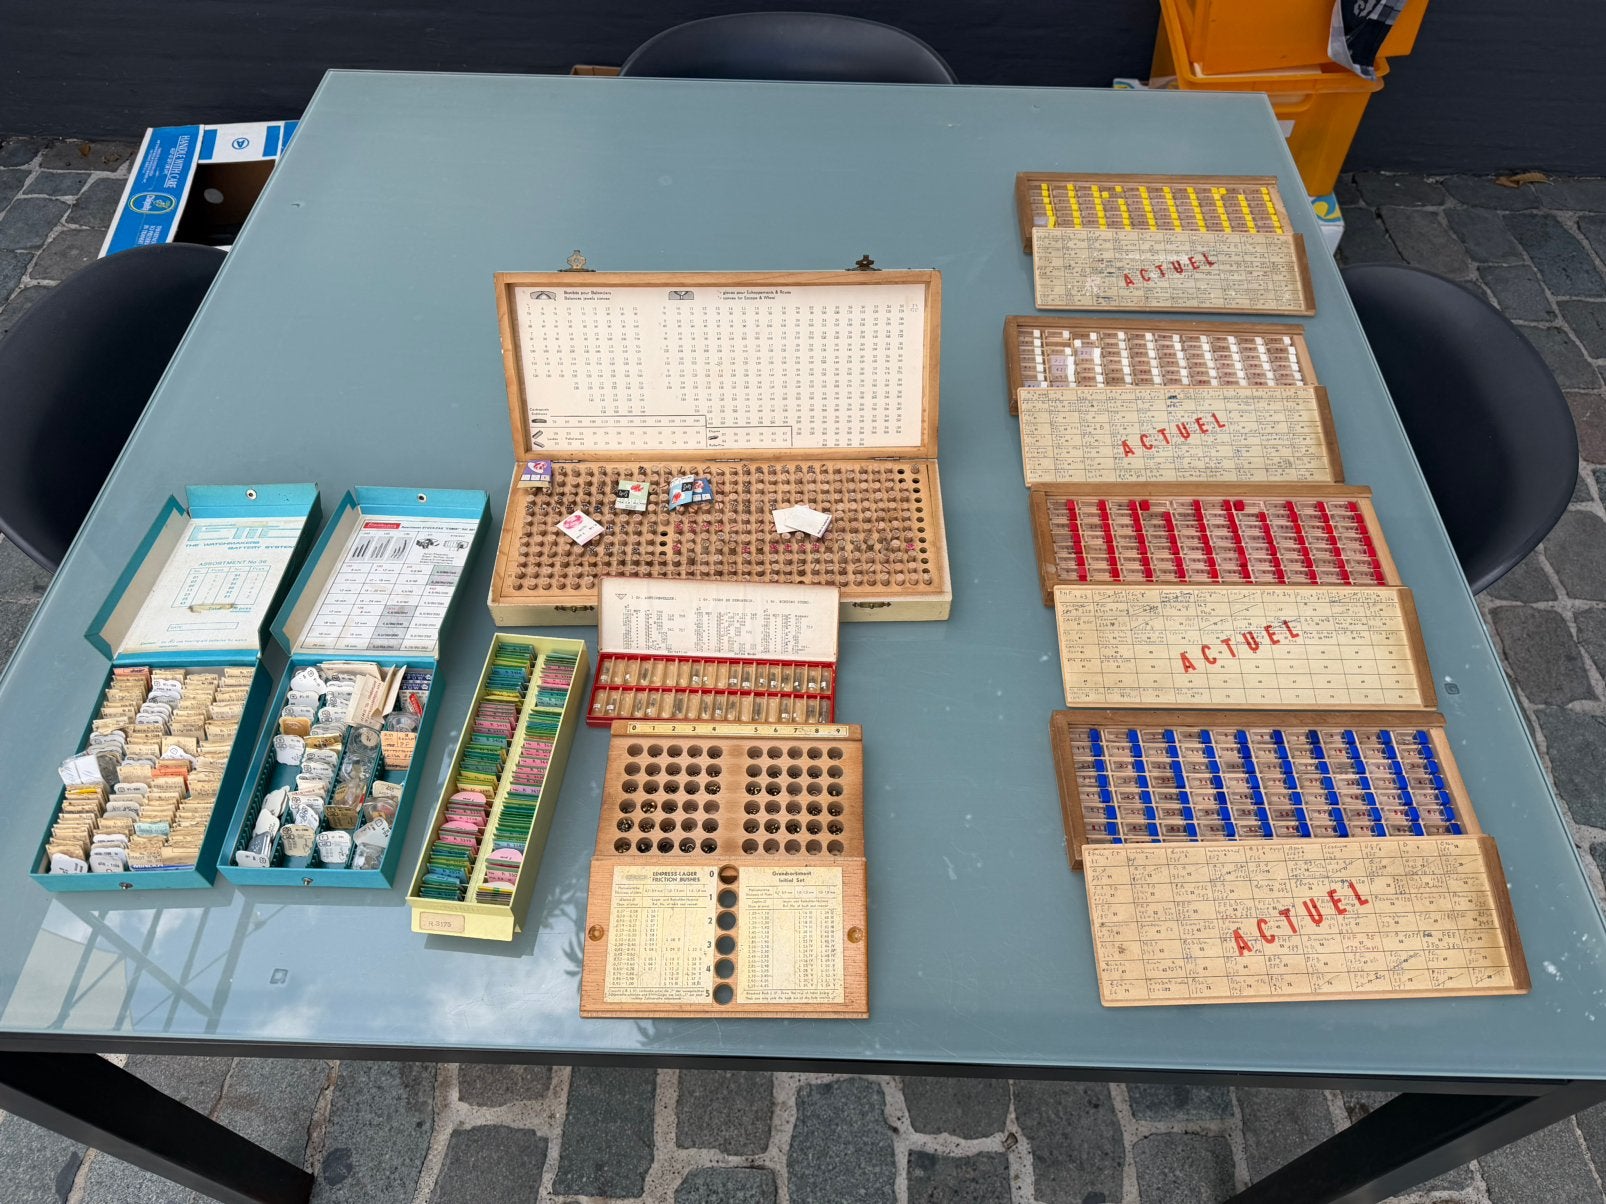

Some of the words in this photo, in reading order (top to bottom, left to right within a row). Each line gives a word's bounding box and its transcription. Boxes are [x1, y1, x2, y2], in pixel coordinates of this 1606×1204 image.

[177, 135, 190, 158] HANDLE
[168, 174, 179, 188] CARE
[172, 159, 184, 174] WITH
[1123, 252, 1217, 287] ACTUEL
[1121, 412, 1227, 458] ACTUEL
[1179, 619, 1300, 674] ACTUEL
[1232, 880, 1371, 957] ACTUEL
